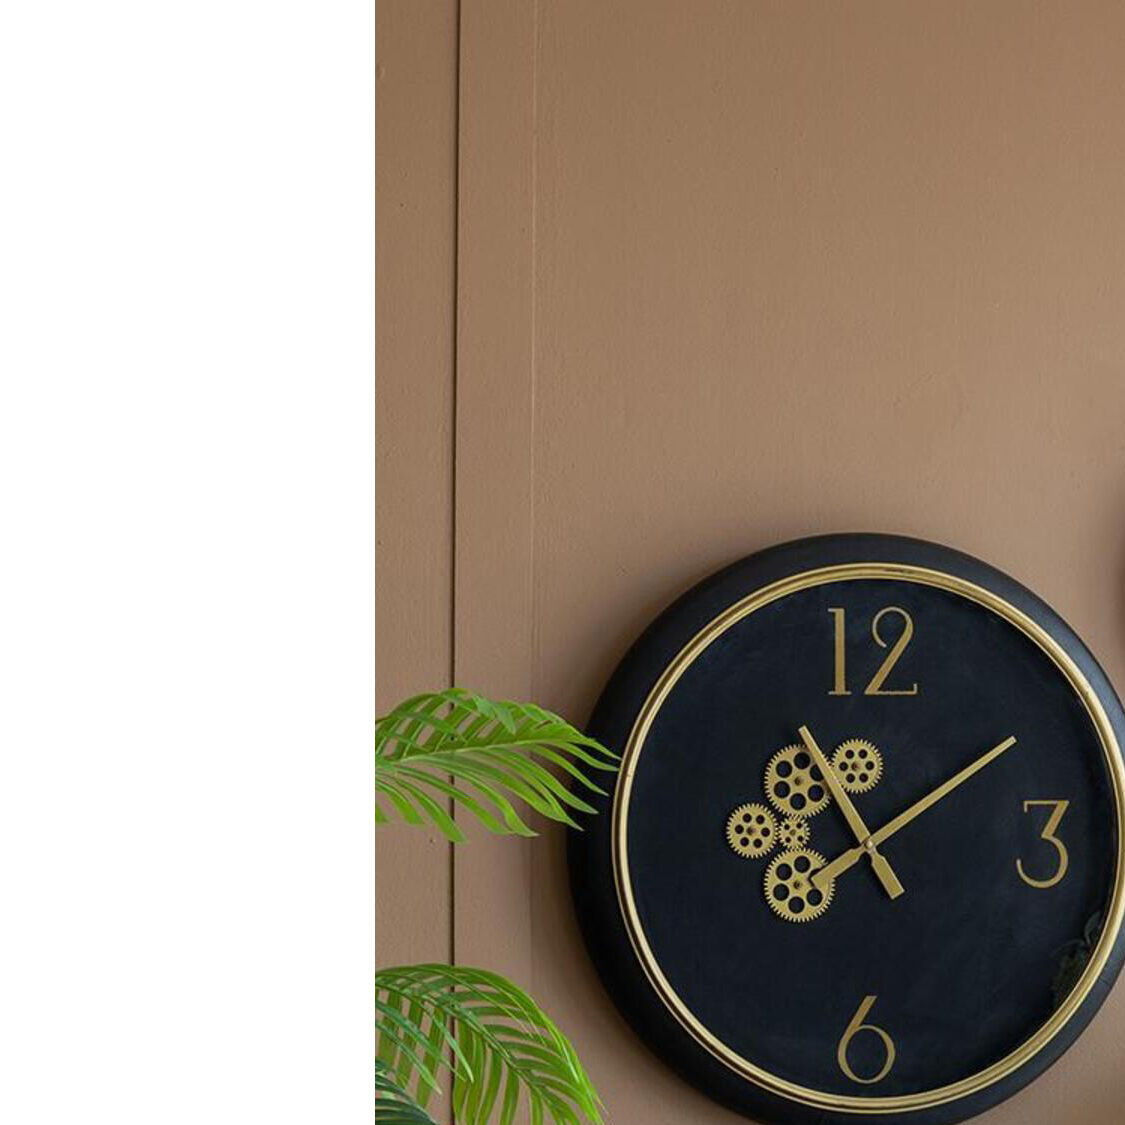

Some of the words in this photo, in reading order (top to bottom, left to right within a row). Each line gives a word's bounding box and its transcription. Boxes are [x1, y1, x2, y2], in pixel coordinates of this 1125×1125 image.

[828, 607, 918, 696] 12
[1016, 800, 1070, 888] 3
[837, 995, 896, 1084] 6
